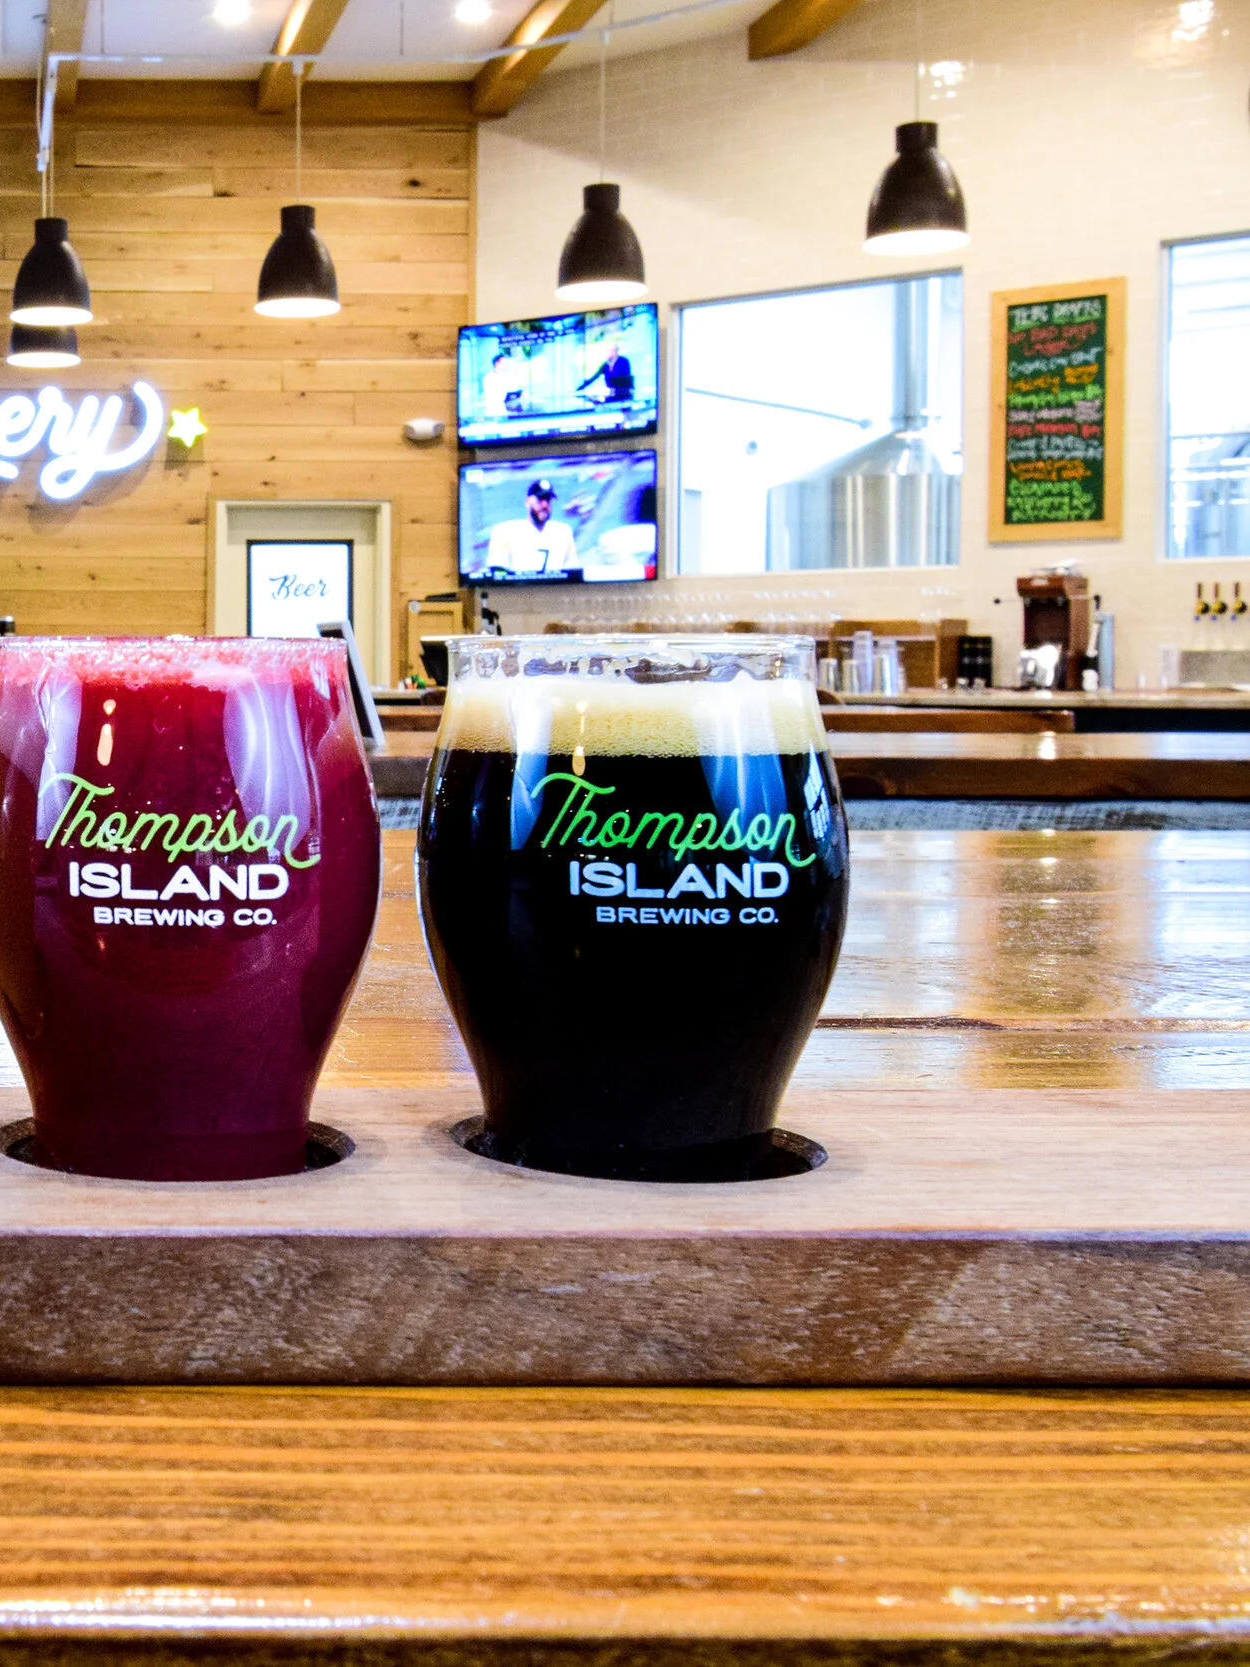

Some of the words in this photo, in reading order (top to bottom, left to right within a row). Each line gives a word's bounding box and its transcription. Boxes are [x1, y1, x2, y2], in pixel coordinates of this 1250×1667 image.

[268, 573, 330, 601] Beer
[38, 772, 321, 869] Thompson
[531, 772, 817, 867] Thompson
[69, 861, 290, 901] ISLAND
[569, 860, 790, 899] ISLAND
[93, 906, 226, 927] BREWING
[233, 907, 278, 926] CO.
[596, 906, 731, 925] BREWING
[738, 906, 780, 924] CO.
